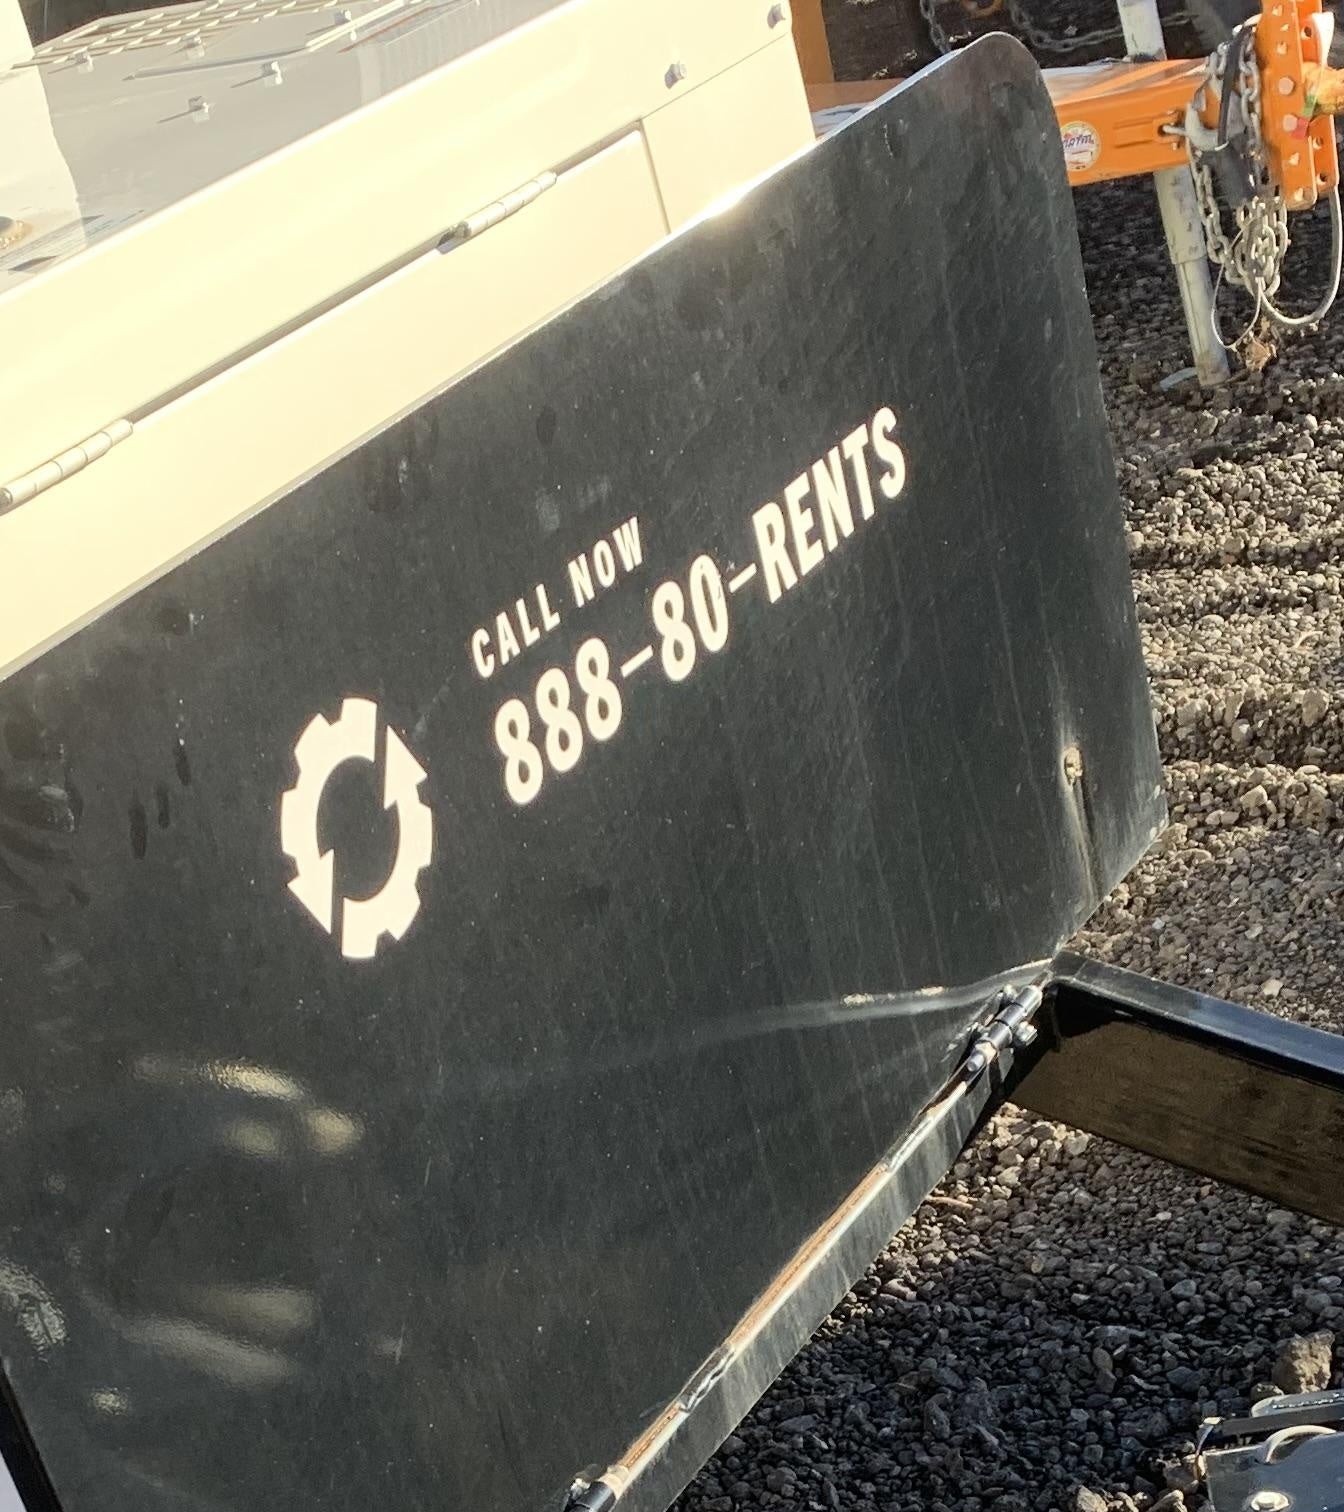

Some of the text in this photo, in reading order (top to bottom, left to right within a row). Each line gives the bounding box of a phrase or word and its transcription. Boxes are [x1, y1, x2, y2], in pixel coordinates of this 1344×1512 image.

[471, 516, 644, 679] CALL NOW
[495, 406, 907, 804] 888-80-RENTS
